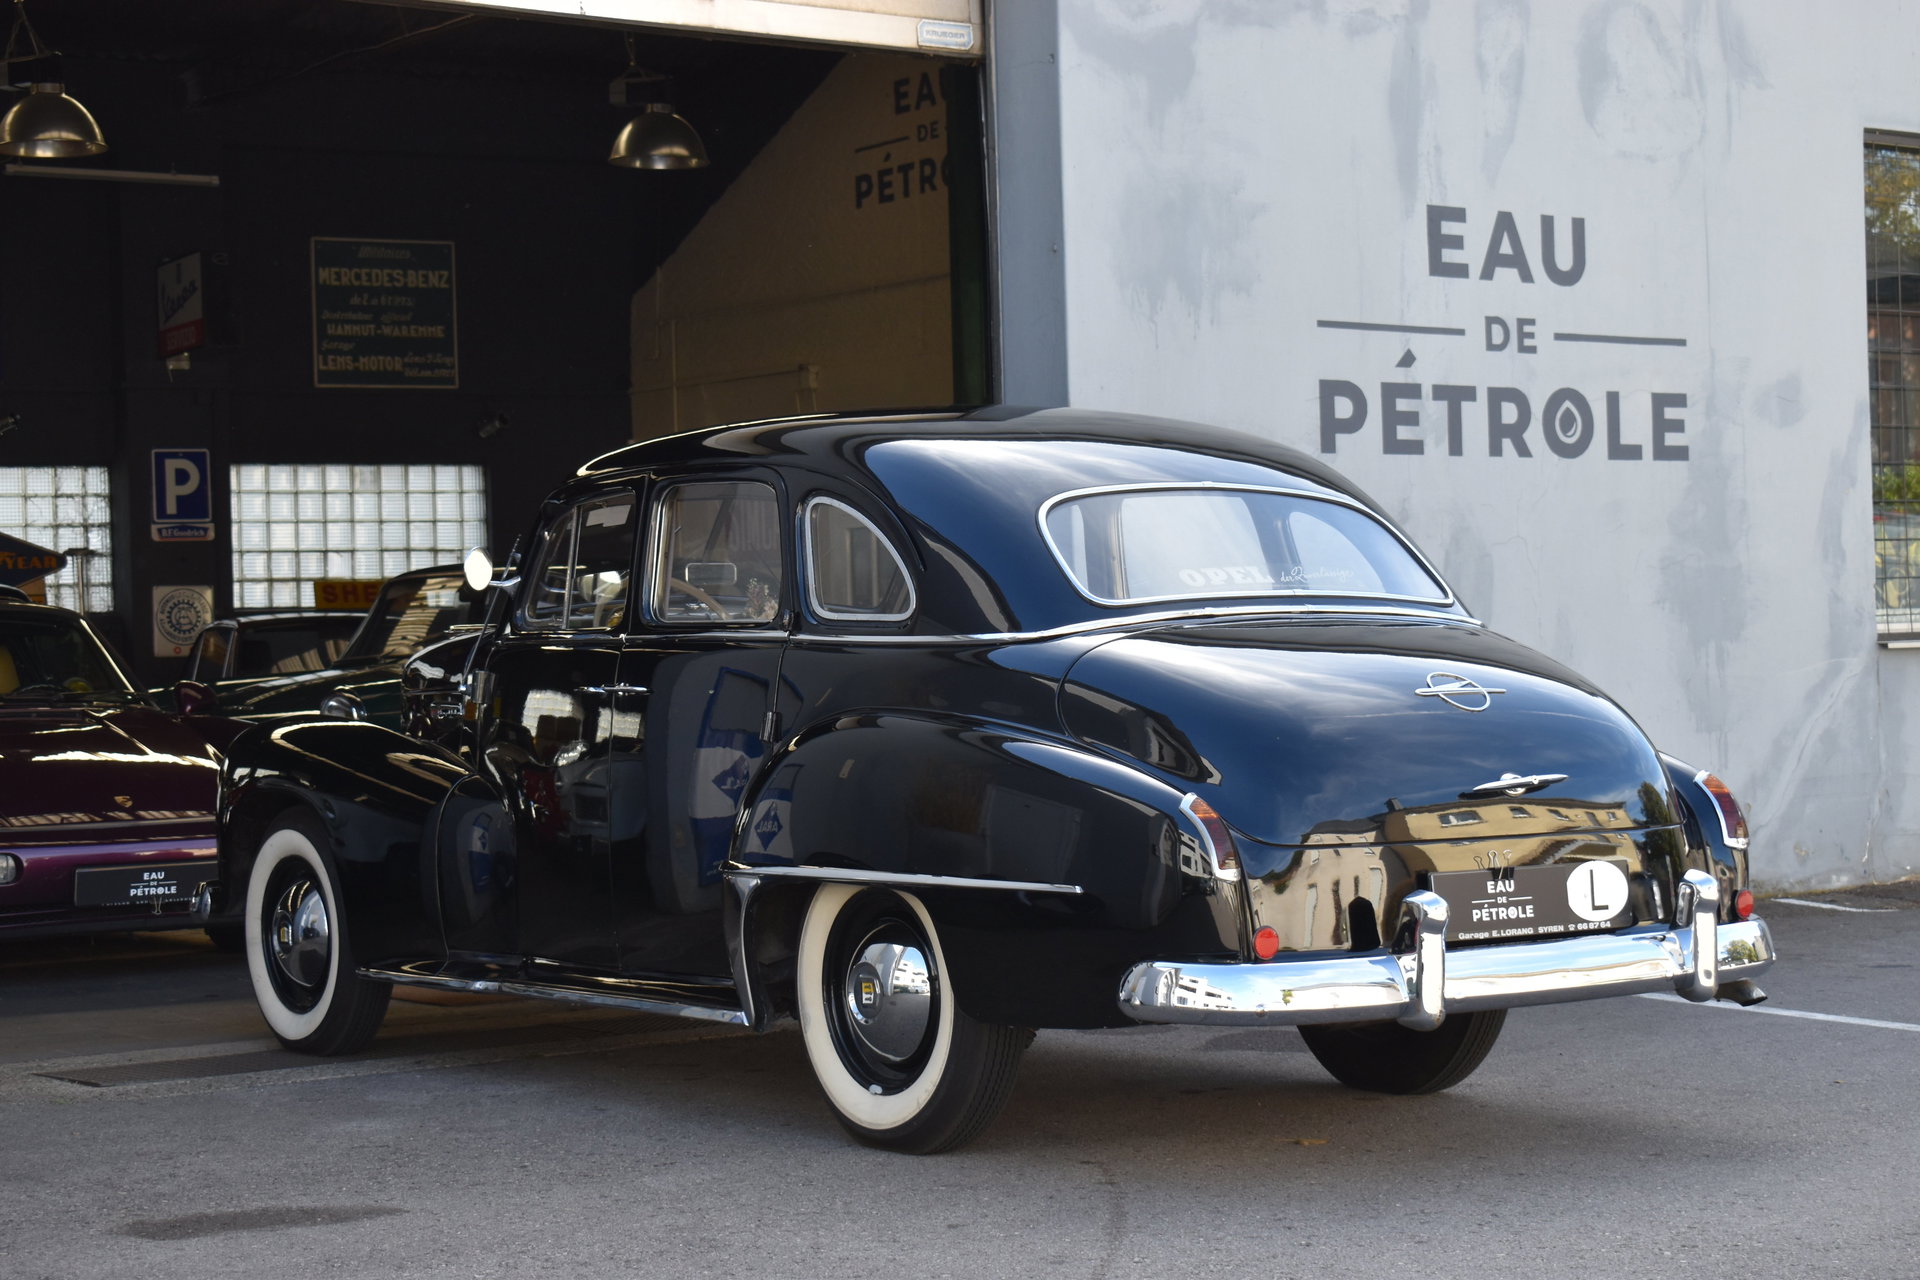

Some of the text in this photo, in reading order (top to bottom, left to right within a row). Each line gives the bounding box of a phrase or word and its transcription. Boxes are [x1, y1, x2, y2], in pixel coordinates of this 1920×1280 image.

[916, 121, 940, 142] DE
[1426, 204, 1586, 287] EAU
[1484, 315, 1537, 354] DE
[1318, 347, 1690, 462] PÉTROLE
[163, 458, 201, 516] P
[1178, 566, 1275, 587] OPEL
[143, 871, 165, 881] EAU
[1487, 880, 1515, 893] EAU
[130, 885, 177, 897] PÉTROLE
[1496, 896, 1508, 904] DE
[1589, 869, 1609, 911] L
[1472, 904, 1534, 922] PÉTROLE
[1458, 932, 1489, 940] Garage
[1538, 925, 1564, 934] SYREN
